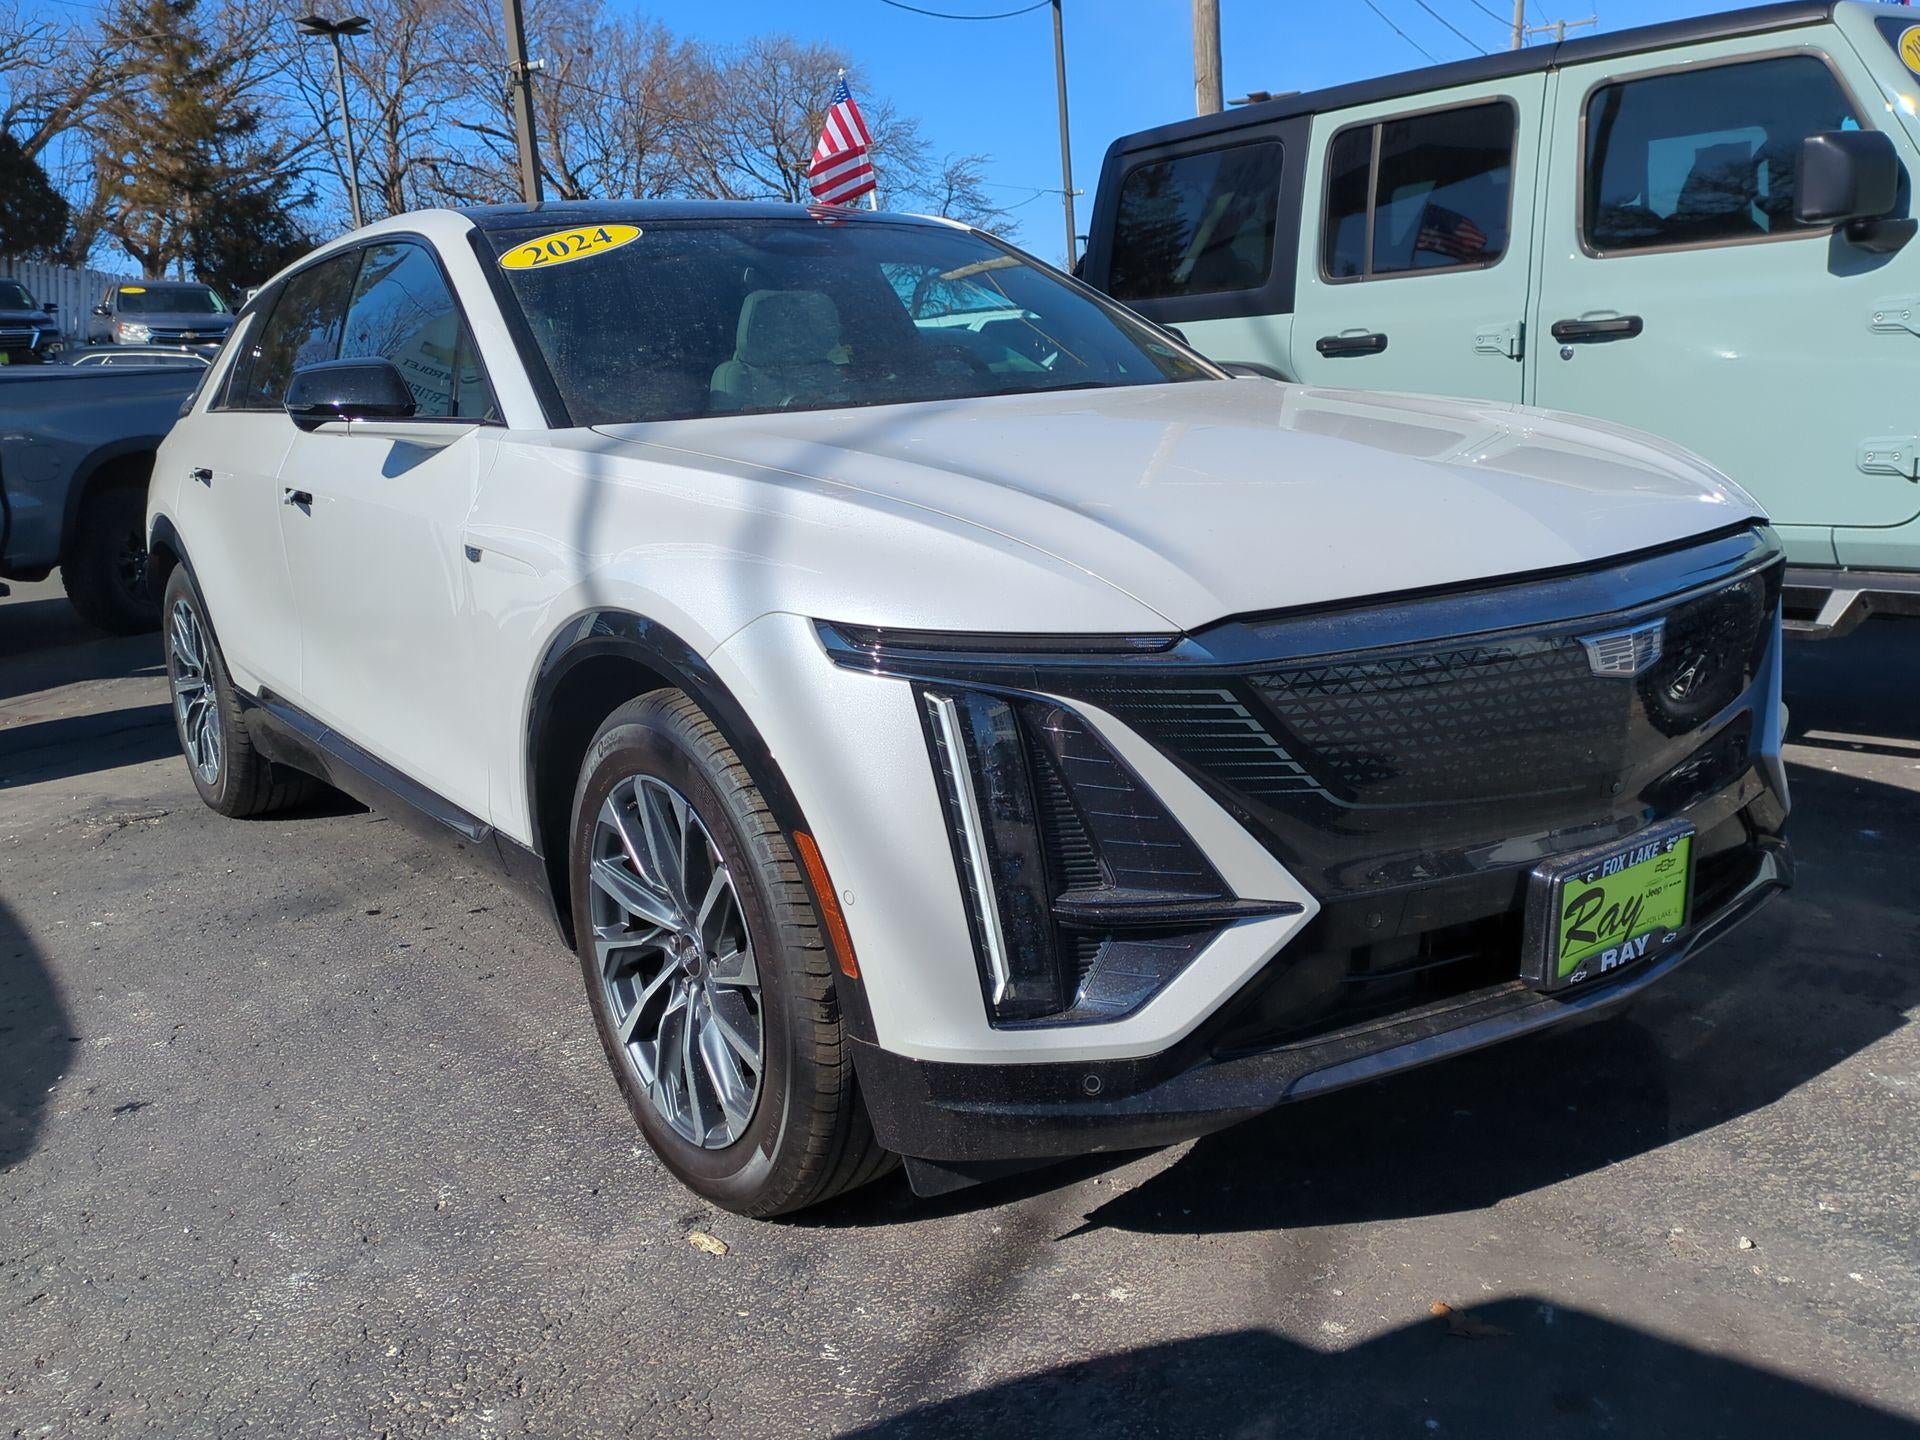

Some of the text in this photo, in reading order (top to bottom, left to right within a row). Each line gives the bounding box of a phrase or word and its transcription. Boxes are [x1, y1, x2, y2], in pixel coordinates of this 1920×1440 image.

[522, 227, 612, 265] 2024
[1601, 853, 1627, 878] FOX
[1628, 840, 1661, 867] LAKE
[1561, 887, 1645, 959] Ray
[1600, 933, 1651, 973] RAY
